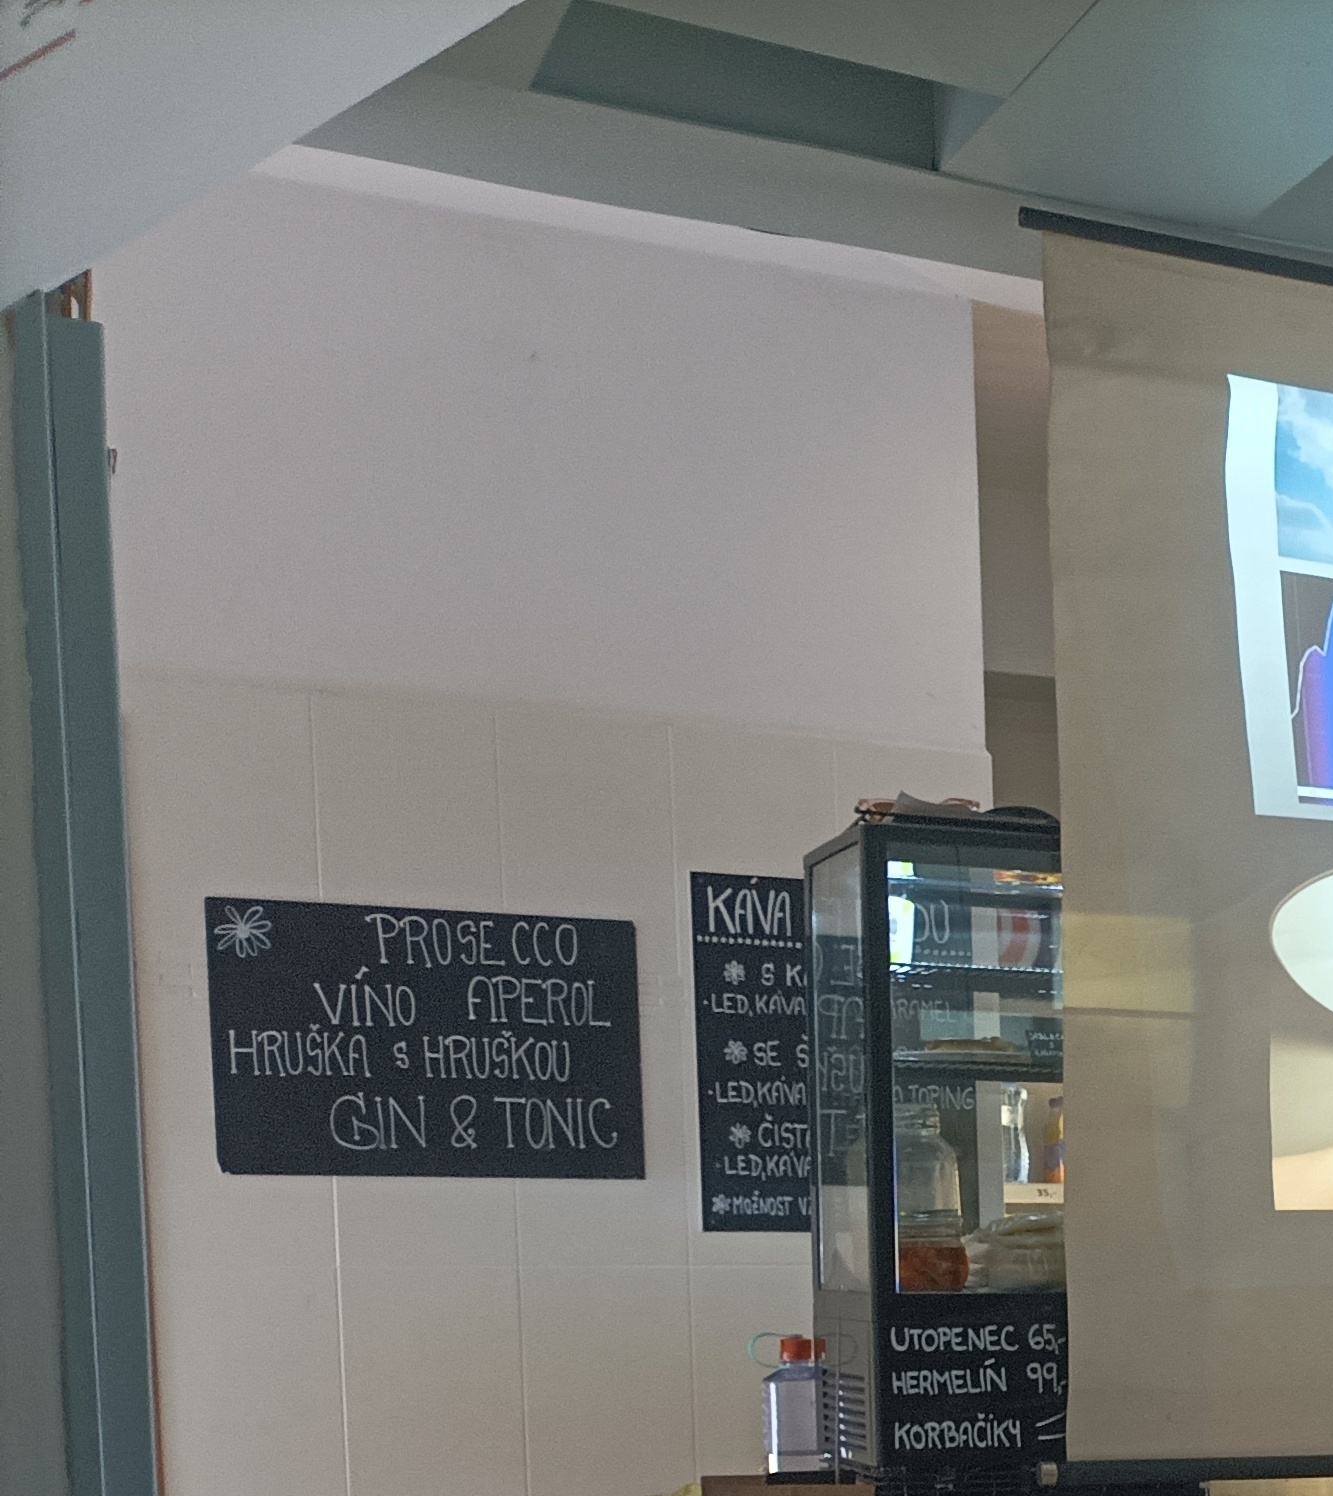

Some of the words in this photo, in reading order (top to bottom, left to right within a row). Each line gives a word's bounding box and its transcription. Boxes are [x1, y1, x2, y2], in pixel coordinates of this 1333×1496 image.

[707, 877, 792, 937] KÁVA
[365, 913, 579, 968] PROSECCO
[313, 966, 416, 1027] VÍNO
[467, 976, 611, 1027] APEROL
[228, 1024, 371, 1079] HRUŠKA
[423, 1031, 570, 1083] HRUŠKOU
[753, 1040, 781, 1067] SE
[329, 1091, 427, 1150] GIN
[450, 1094, 478, 1150] &
[494, 1096, 618, 1150] TONIC
[732, 1190, 793, 1217] MOŽNOST
[890, 1324, 1019, 1352] UTOPENEC
[892, 1357, 1008, 1396] HERMELÍN
